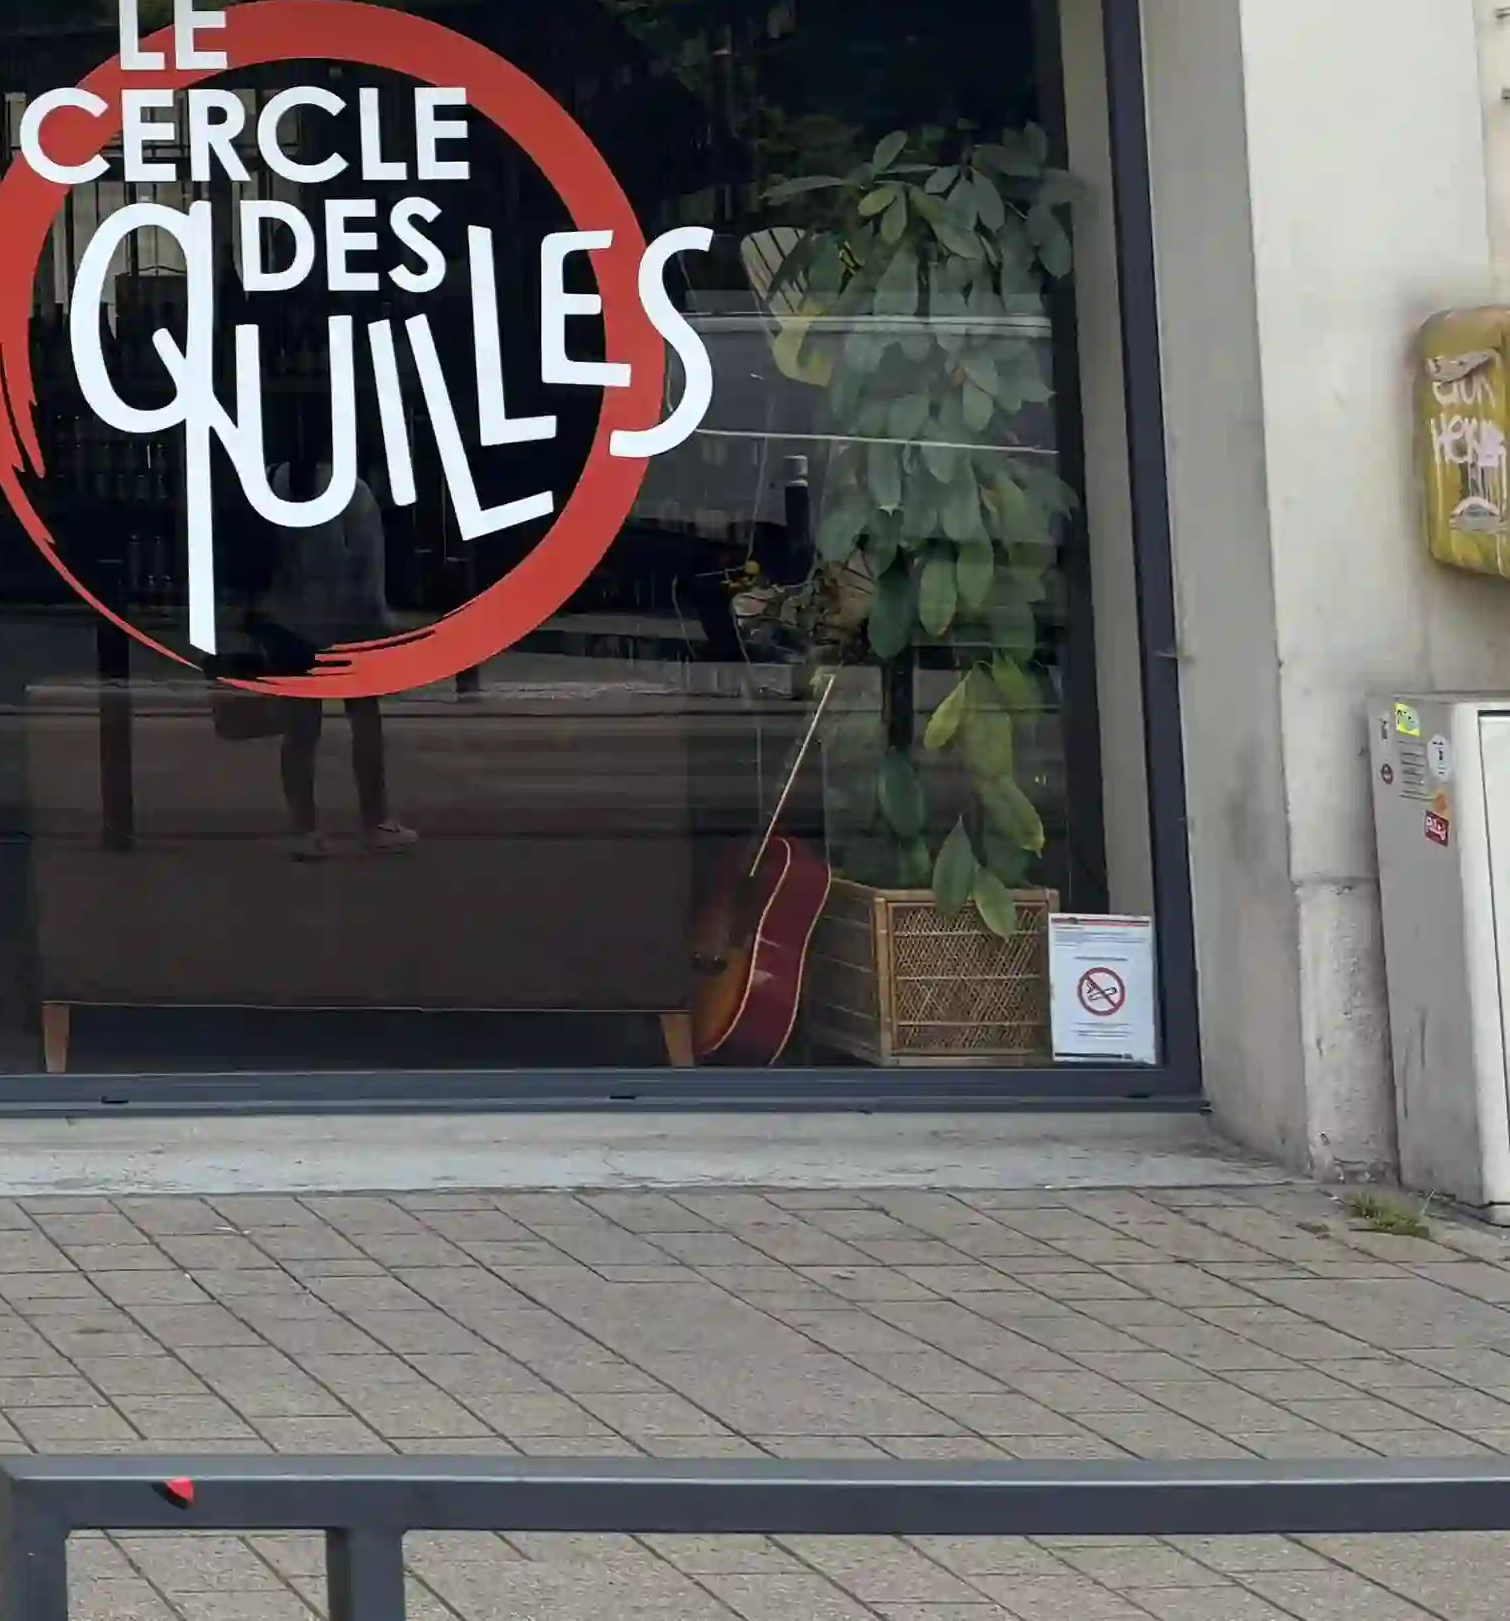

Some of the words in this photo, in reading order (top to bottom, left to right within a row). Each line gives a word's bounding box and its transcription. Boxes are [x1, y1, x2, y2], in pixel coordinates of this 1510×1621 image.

[19, 86, 470, 184] CERCLE
[240, 197, 446, 292] DES
[70, 201, 714, 655] QUILLES
